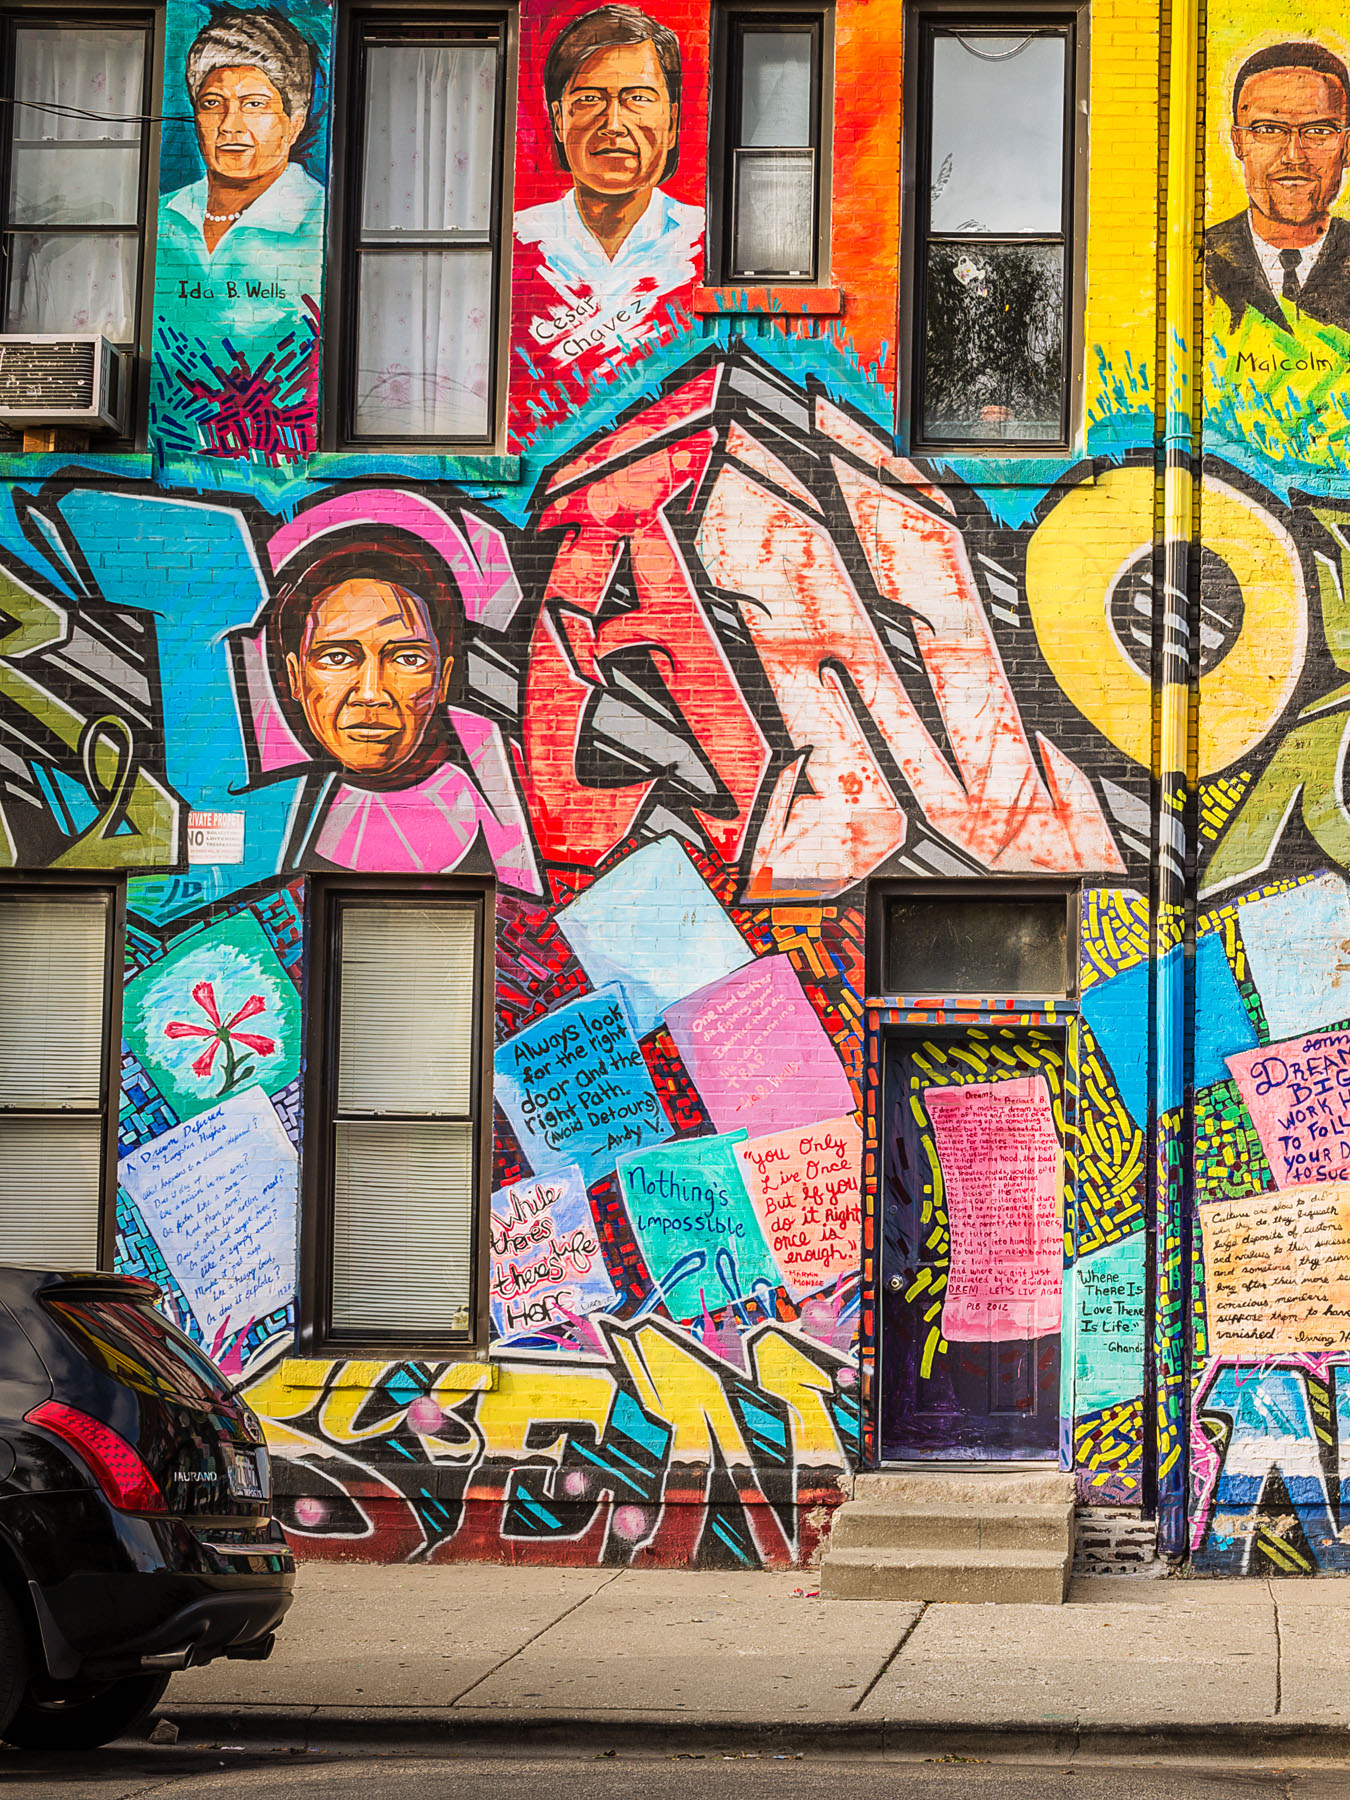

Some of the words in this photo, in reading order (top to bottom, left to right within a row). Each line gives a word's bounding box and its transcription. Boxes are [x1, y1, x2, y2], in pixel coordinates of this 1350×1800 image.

[178, 280, 214, 299] Ida
[226, 281, 240, 298] B.
[245, 281, 286, 299] Wells
[536, 295, 594, 339] Cesar
[563, 300, 647, 356] Chavez
[1236, 351, 1333, 373] Malcolm
[514, 1025, 580, 1066] Always
[578, 1003, 625, 1034] look
[523, 1062, 555, 1085] for
[556, 1044, 588, 1069] the
[589, 1025, 627, 1053] right
[521, 1079, 570, 1114] door
[609, 1050, 645, 1071] the
[524, 1103, 577, 1135] right
[587, 1091, 660, 1127] Detours)
[1278, 1098, 1333, 1131] WORK
[644, 1117, 665, 1134] V.
[799, 1134, 847, 1158] Only
[1278, 1136, 1301, 1151] TO
[628, 1166, 728, 1218] Nothing's
[762, 1171, 802, 1194] Live
[806, 1159, 852, 1180] Once
[491, 1184, 562, 1231] While
[765, 1192, 797, 1218] But
[802, 1182, 824, 1205] if
[826, 1177, 858, 1205] you
[638, 1214, 746, 1238] impossible
[771, 1217, 796, 1233] do
[802, 1206, 821, 1226] it
[774, 1232, 811, 1251] once
[819, 1223, 845, 1242] is
[1126, 1282, 1143, 1297] Is
[1082, 1301, 1113, 1316] Love
[1080, 1320, 1099, 1333] Is
